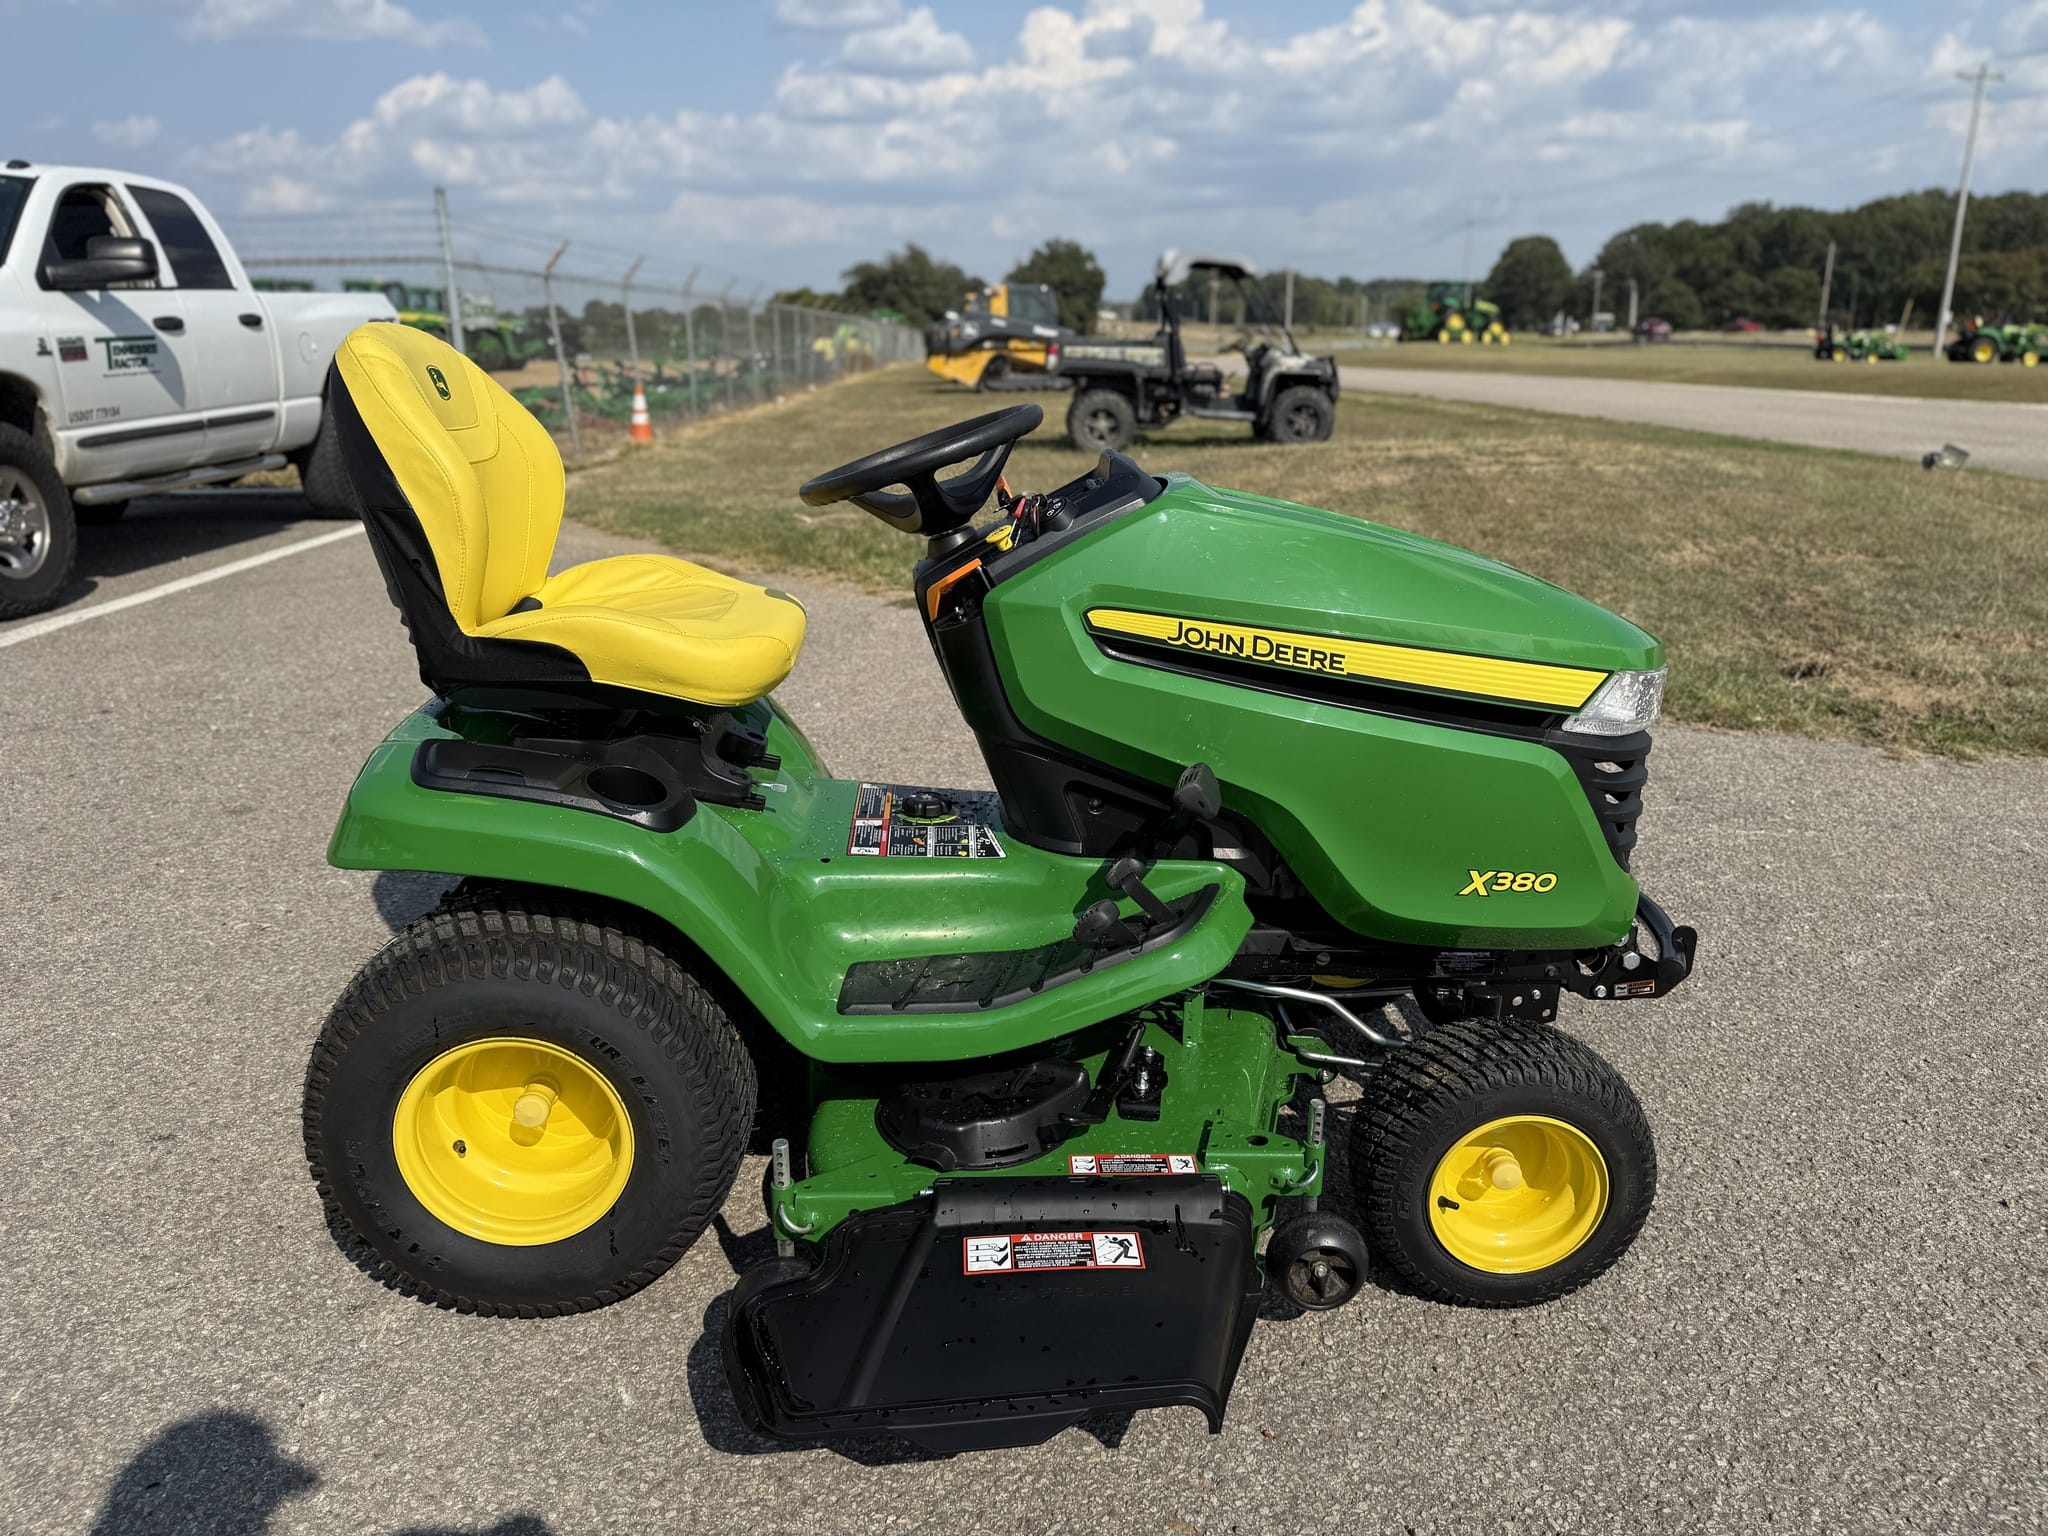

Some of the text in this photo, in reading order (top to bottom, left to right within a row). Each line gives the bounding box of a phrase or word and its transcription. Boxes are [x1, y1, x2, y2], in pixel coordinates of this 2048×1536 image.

[1167, 621, 1346, 672] JOHN DEERE
[1458, 869, 1558, 897] X380
[575, 1026, 635, 1071] TURF
[1034, 1233, 1083, 1241] DANGER
